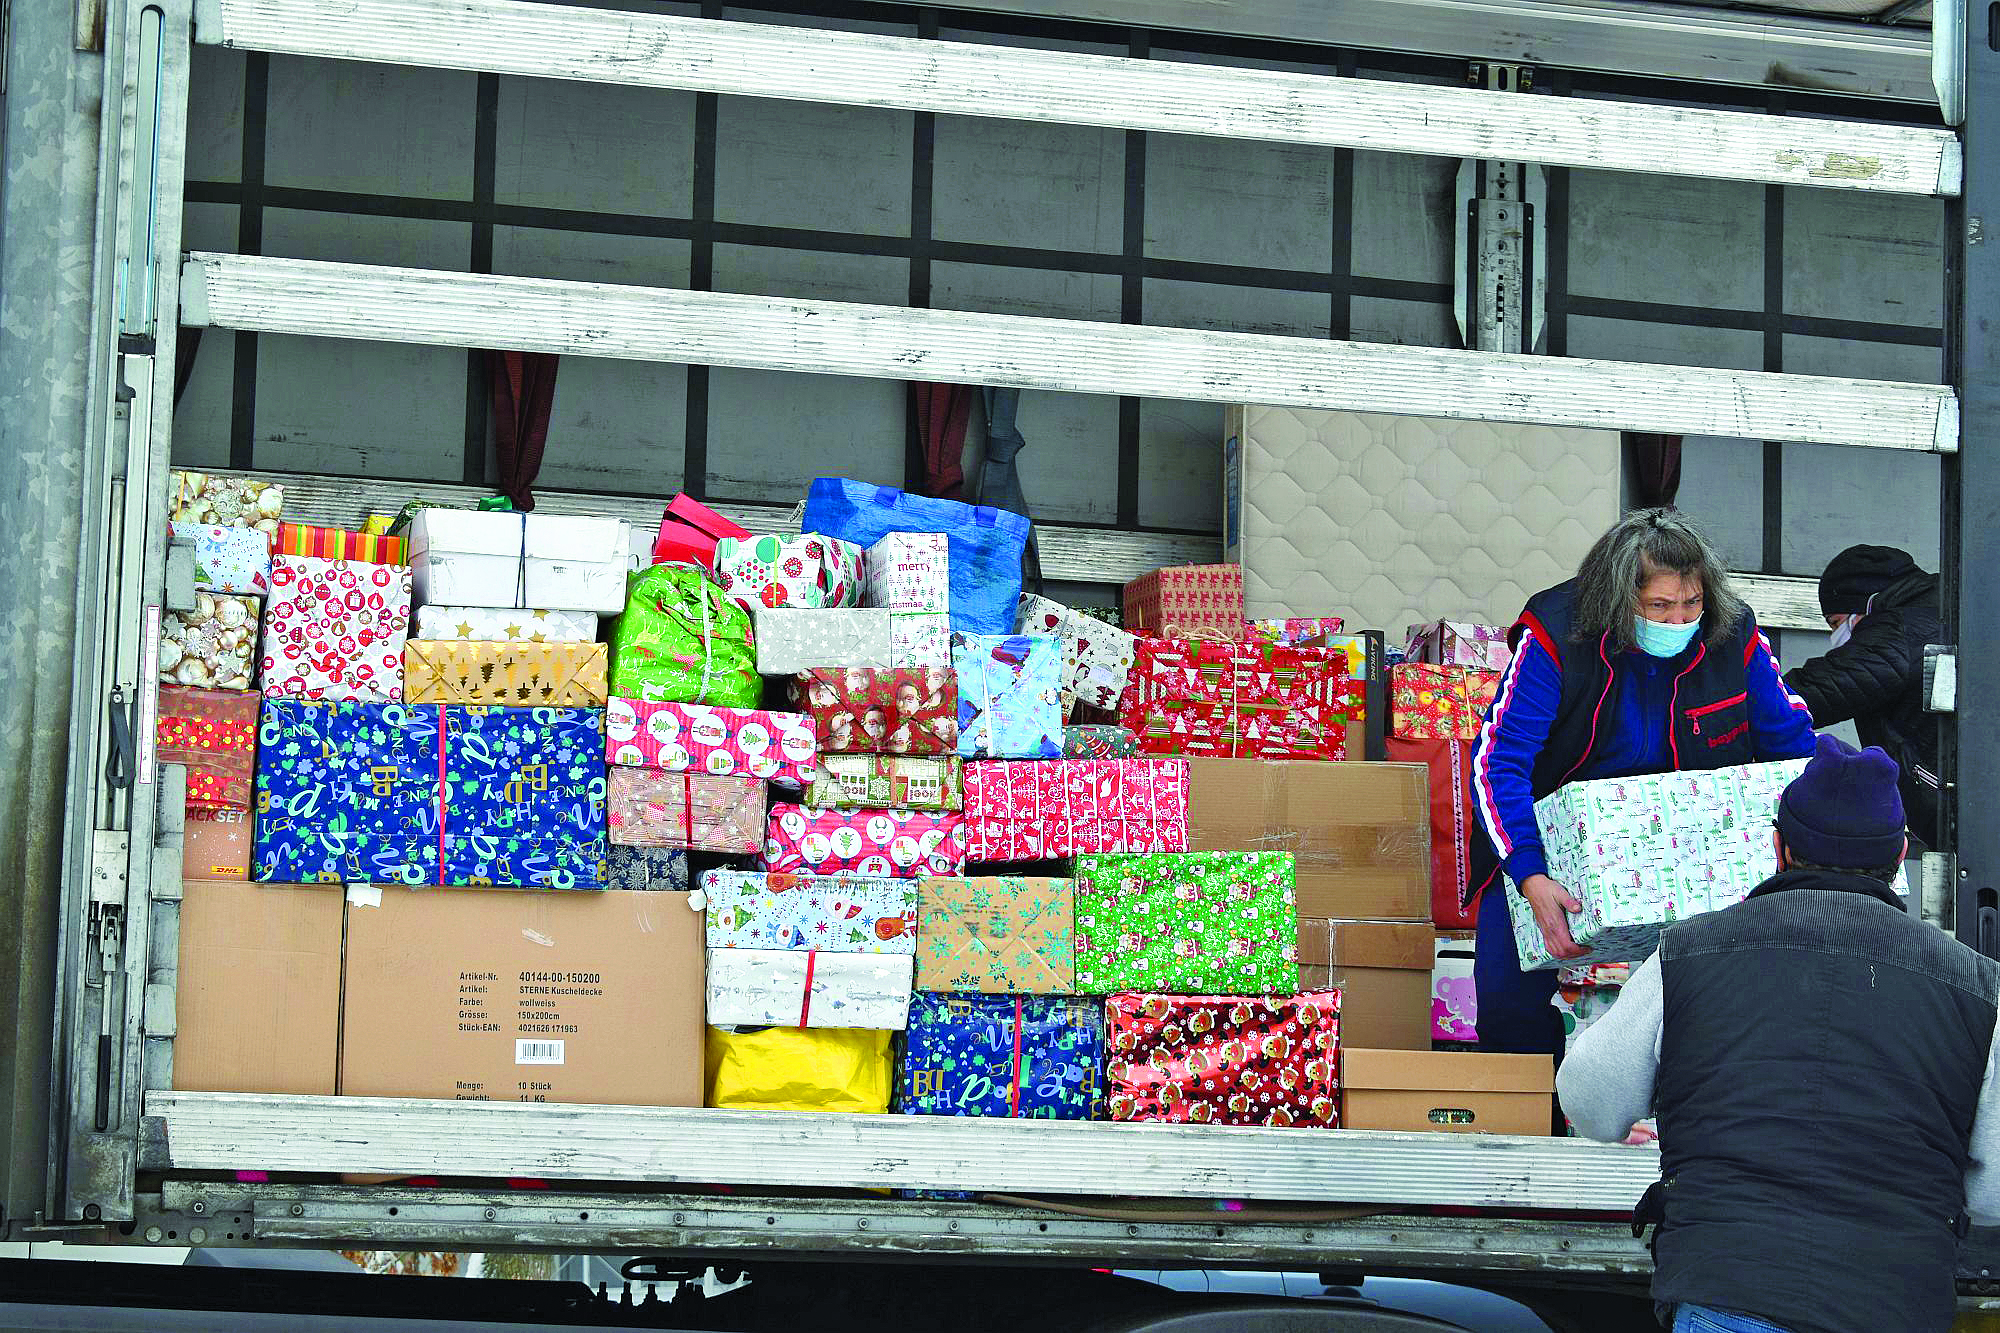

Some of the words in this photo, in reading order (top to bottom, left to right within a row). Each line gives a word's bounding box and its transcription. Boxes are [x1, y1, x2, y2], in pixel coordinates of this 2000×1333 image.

[186, 808, 245, 823] ACKSET
[460, 972, 498, 981] Artikel-Nr.
[519, 972, 600, 983] 40144-00-150200
[459, 985, 488, 993] Artikel:
[519, 986, 550, 994] STERNE
[551, 987, 603, 996] Kuscheldecke
[459, 998, 483, 1006] Farbe:
[519, 999, 556, 1007] wollweiss
[459, 1010, 488, 1019] Grösse:
[518, 1011, 560, 1020] 150x200cm
[458, 1023, 501, 1032] Stück-EAN:
[518, 1024, 550, 1032] 4021626
[551, 1025, 578, 1033] 171963
[456, 1081, 484, 1091] Menge:
[518, 1082, 527, 1090] 10
[530, 1081, 552, 1090] Stück
[534, 1095, 546, 1103] KG
